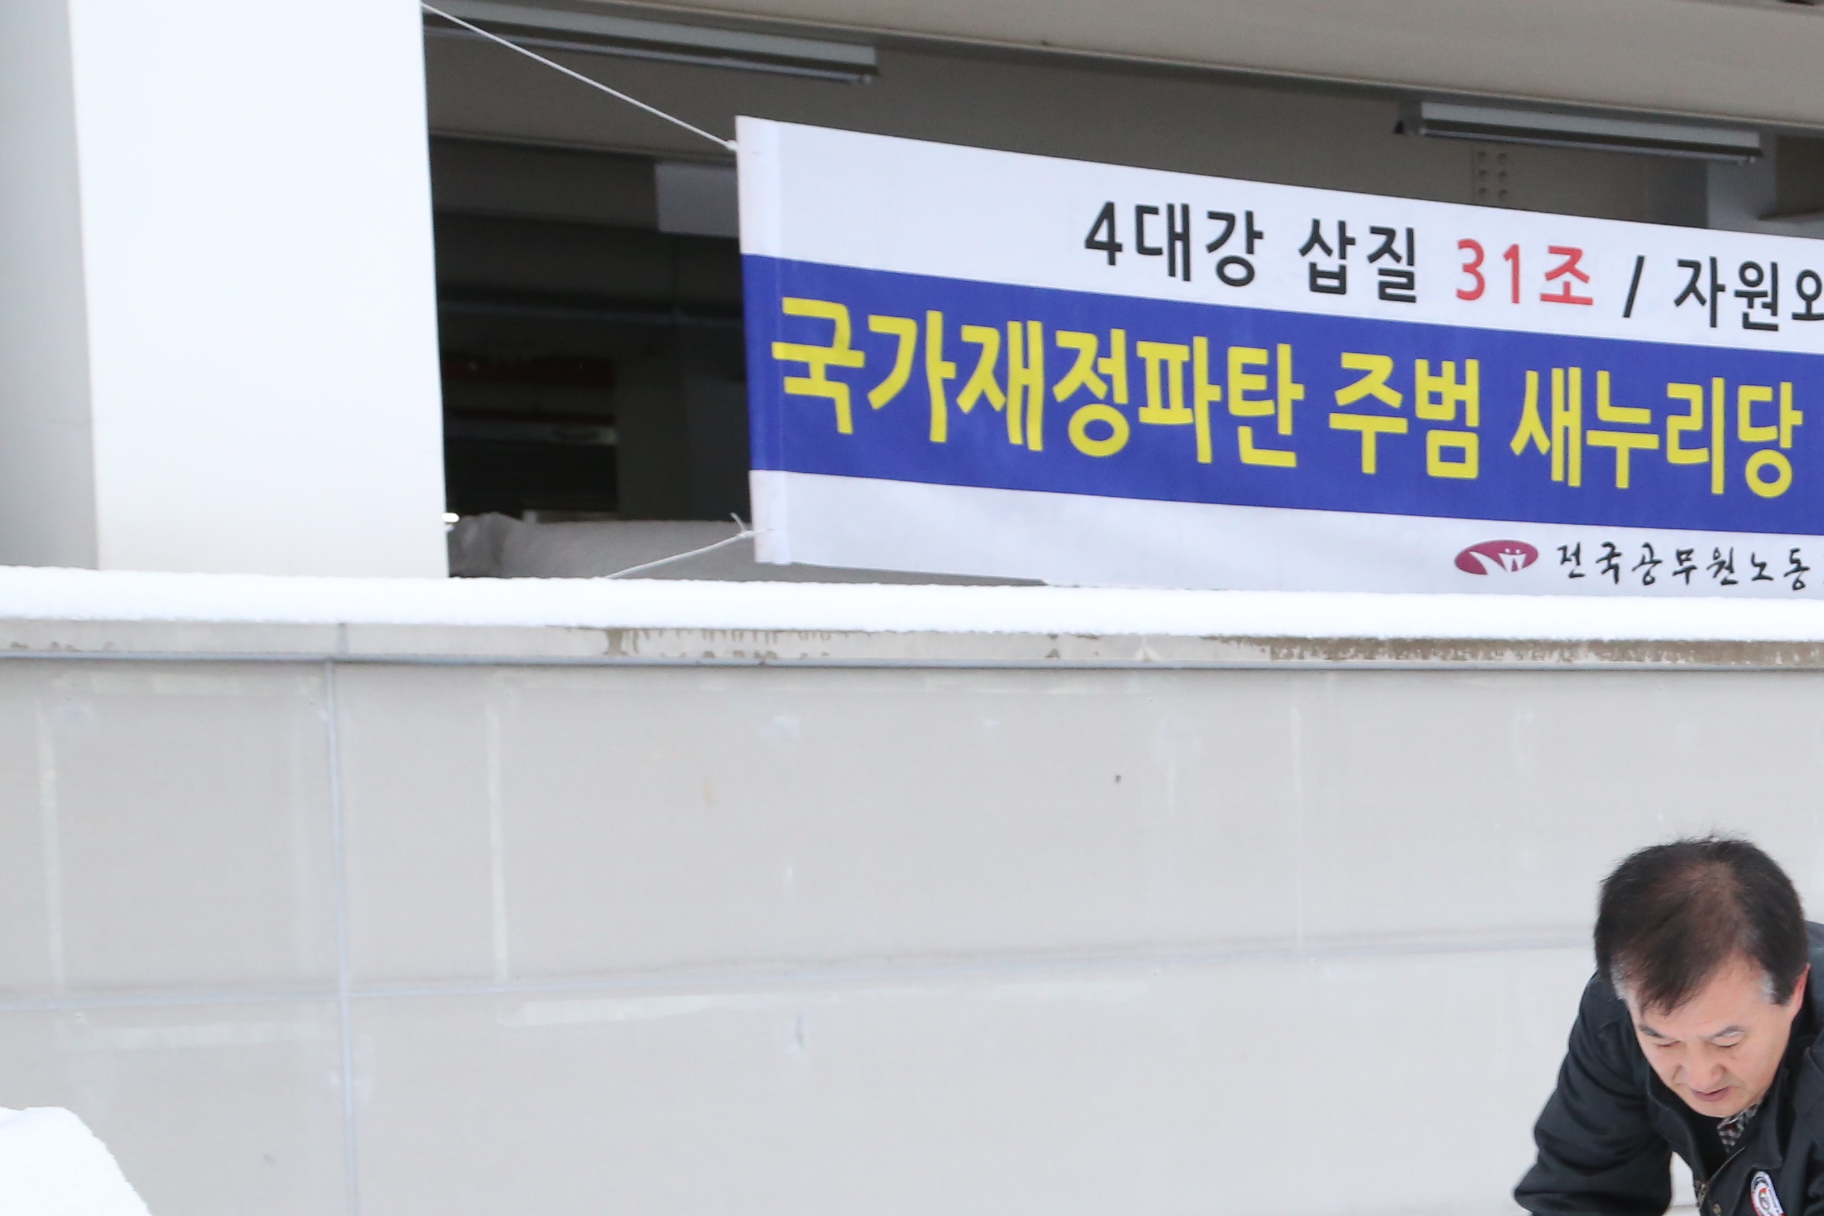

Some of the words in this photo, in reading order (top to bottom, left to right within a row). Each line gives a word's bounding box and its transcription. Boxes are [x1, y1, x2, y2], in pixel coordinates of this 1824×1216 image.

[1085, 202, 1264, 288] 4대강
[1298, 218, 1418, 305] 삽질
[1455, 237, 1595, 308] 31조
[1623, 256, 1646, 319] /
[771, 297, 1306, 470] 국가재정파탄
[1329, 352, 1482, 482] 주범
[1509, 366, 1803, 500] 새누리당
